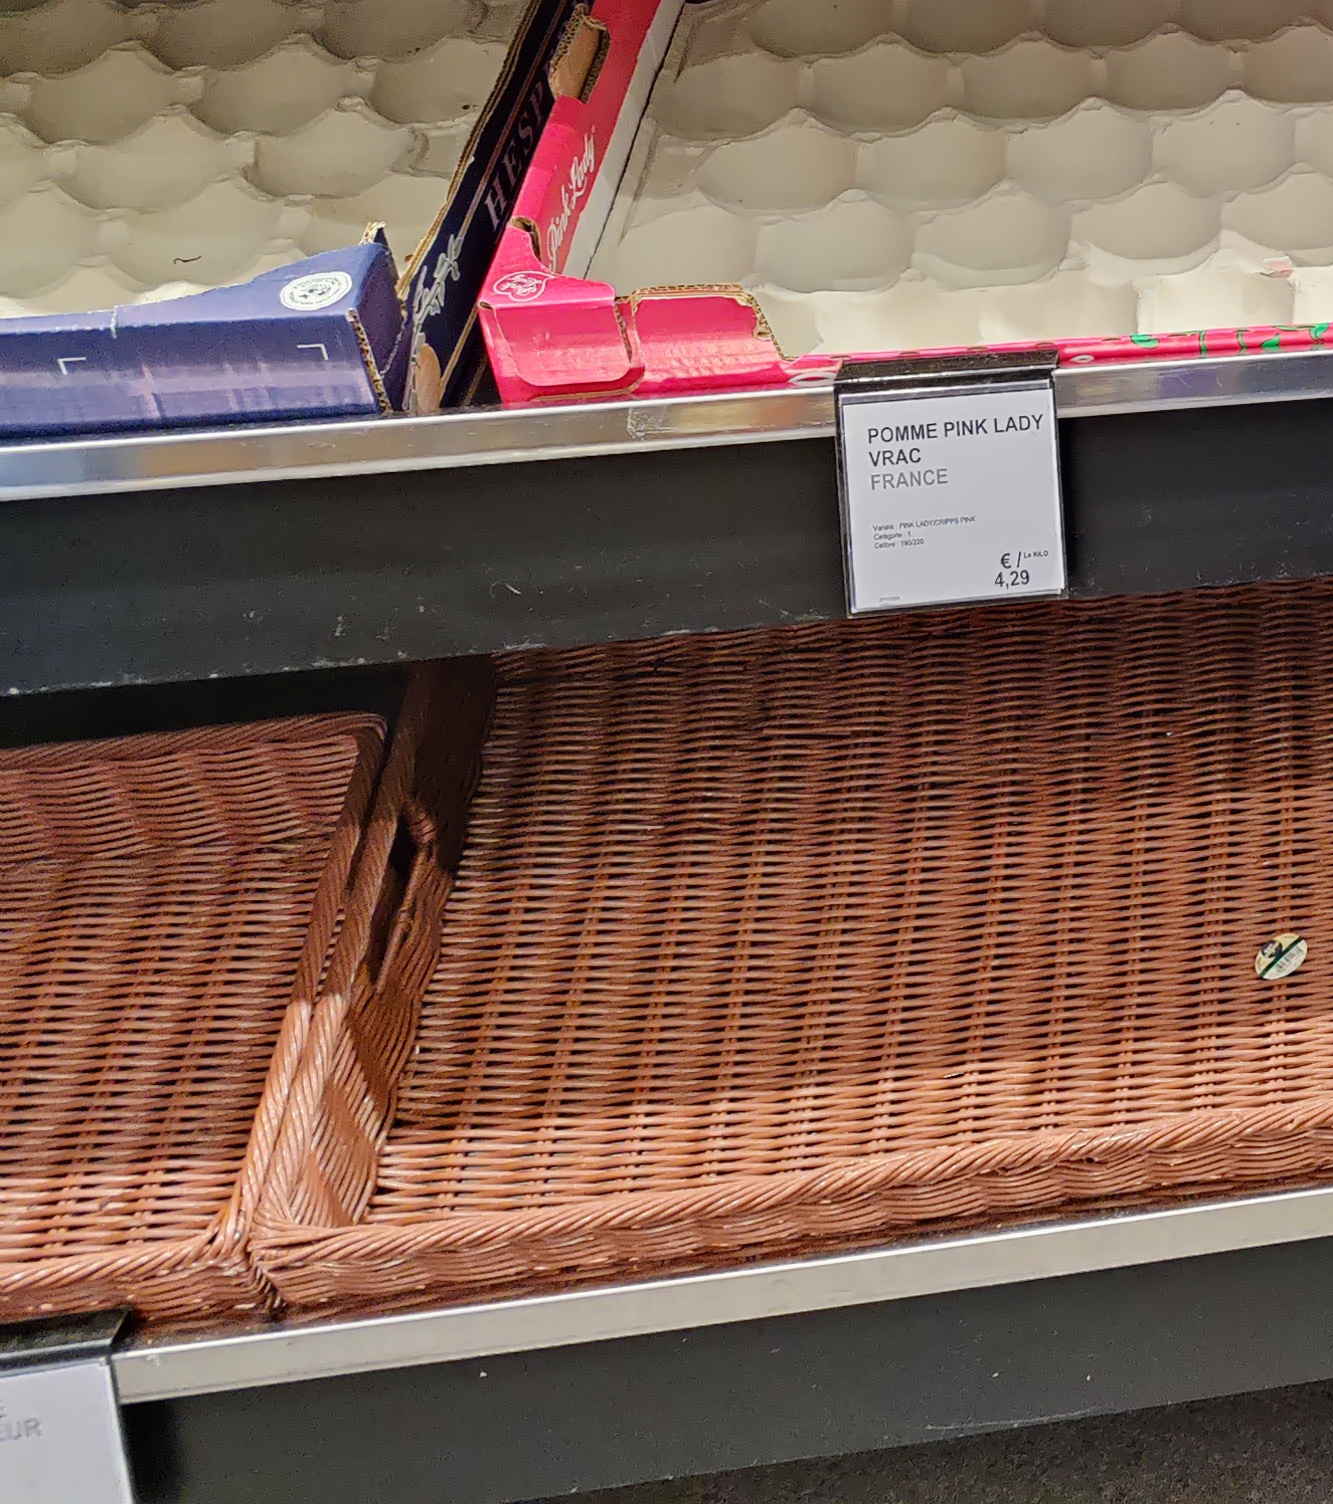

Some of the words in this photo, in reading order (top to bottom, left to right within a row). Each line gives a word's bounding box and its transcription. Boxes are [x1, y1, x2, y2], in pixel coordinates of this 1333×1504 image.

[867, 422, 937, 444] POMME
[944, 418, 988, 438] PINK
[994, 414, 1044, 434] LADY
[868, 447, 921, 467] VRAC
[870, 468, 948, 490] FRANCE
[994, 570, 1030, 590] 4,29
